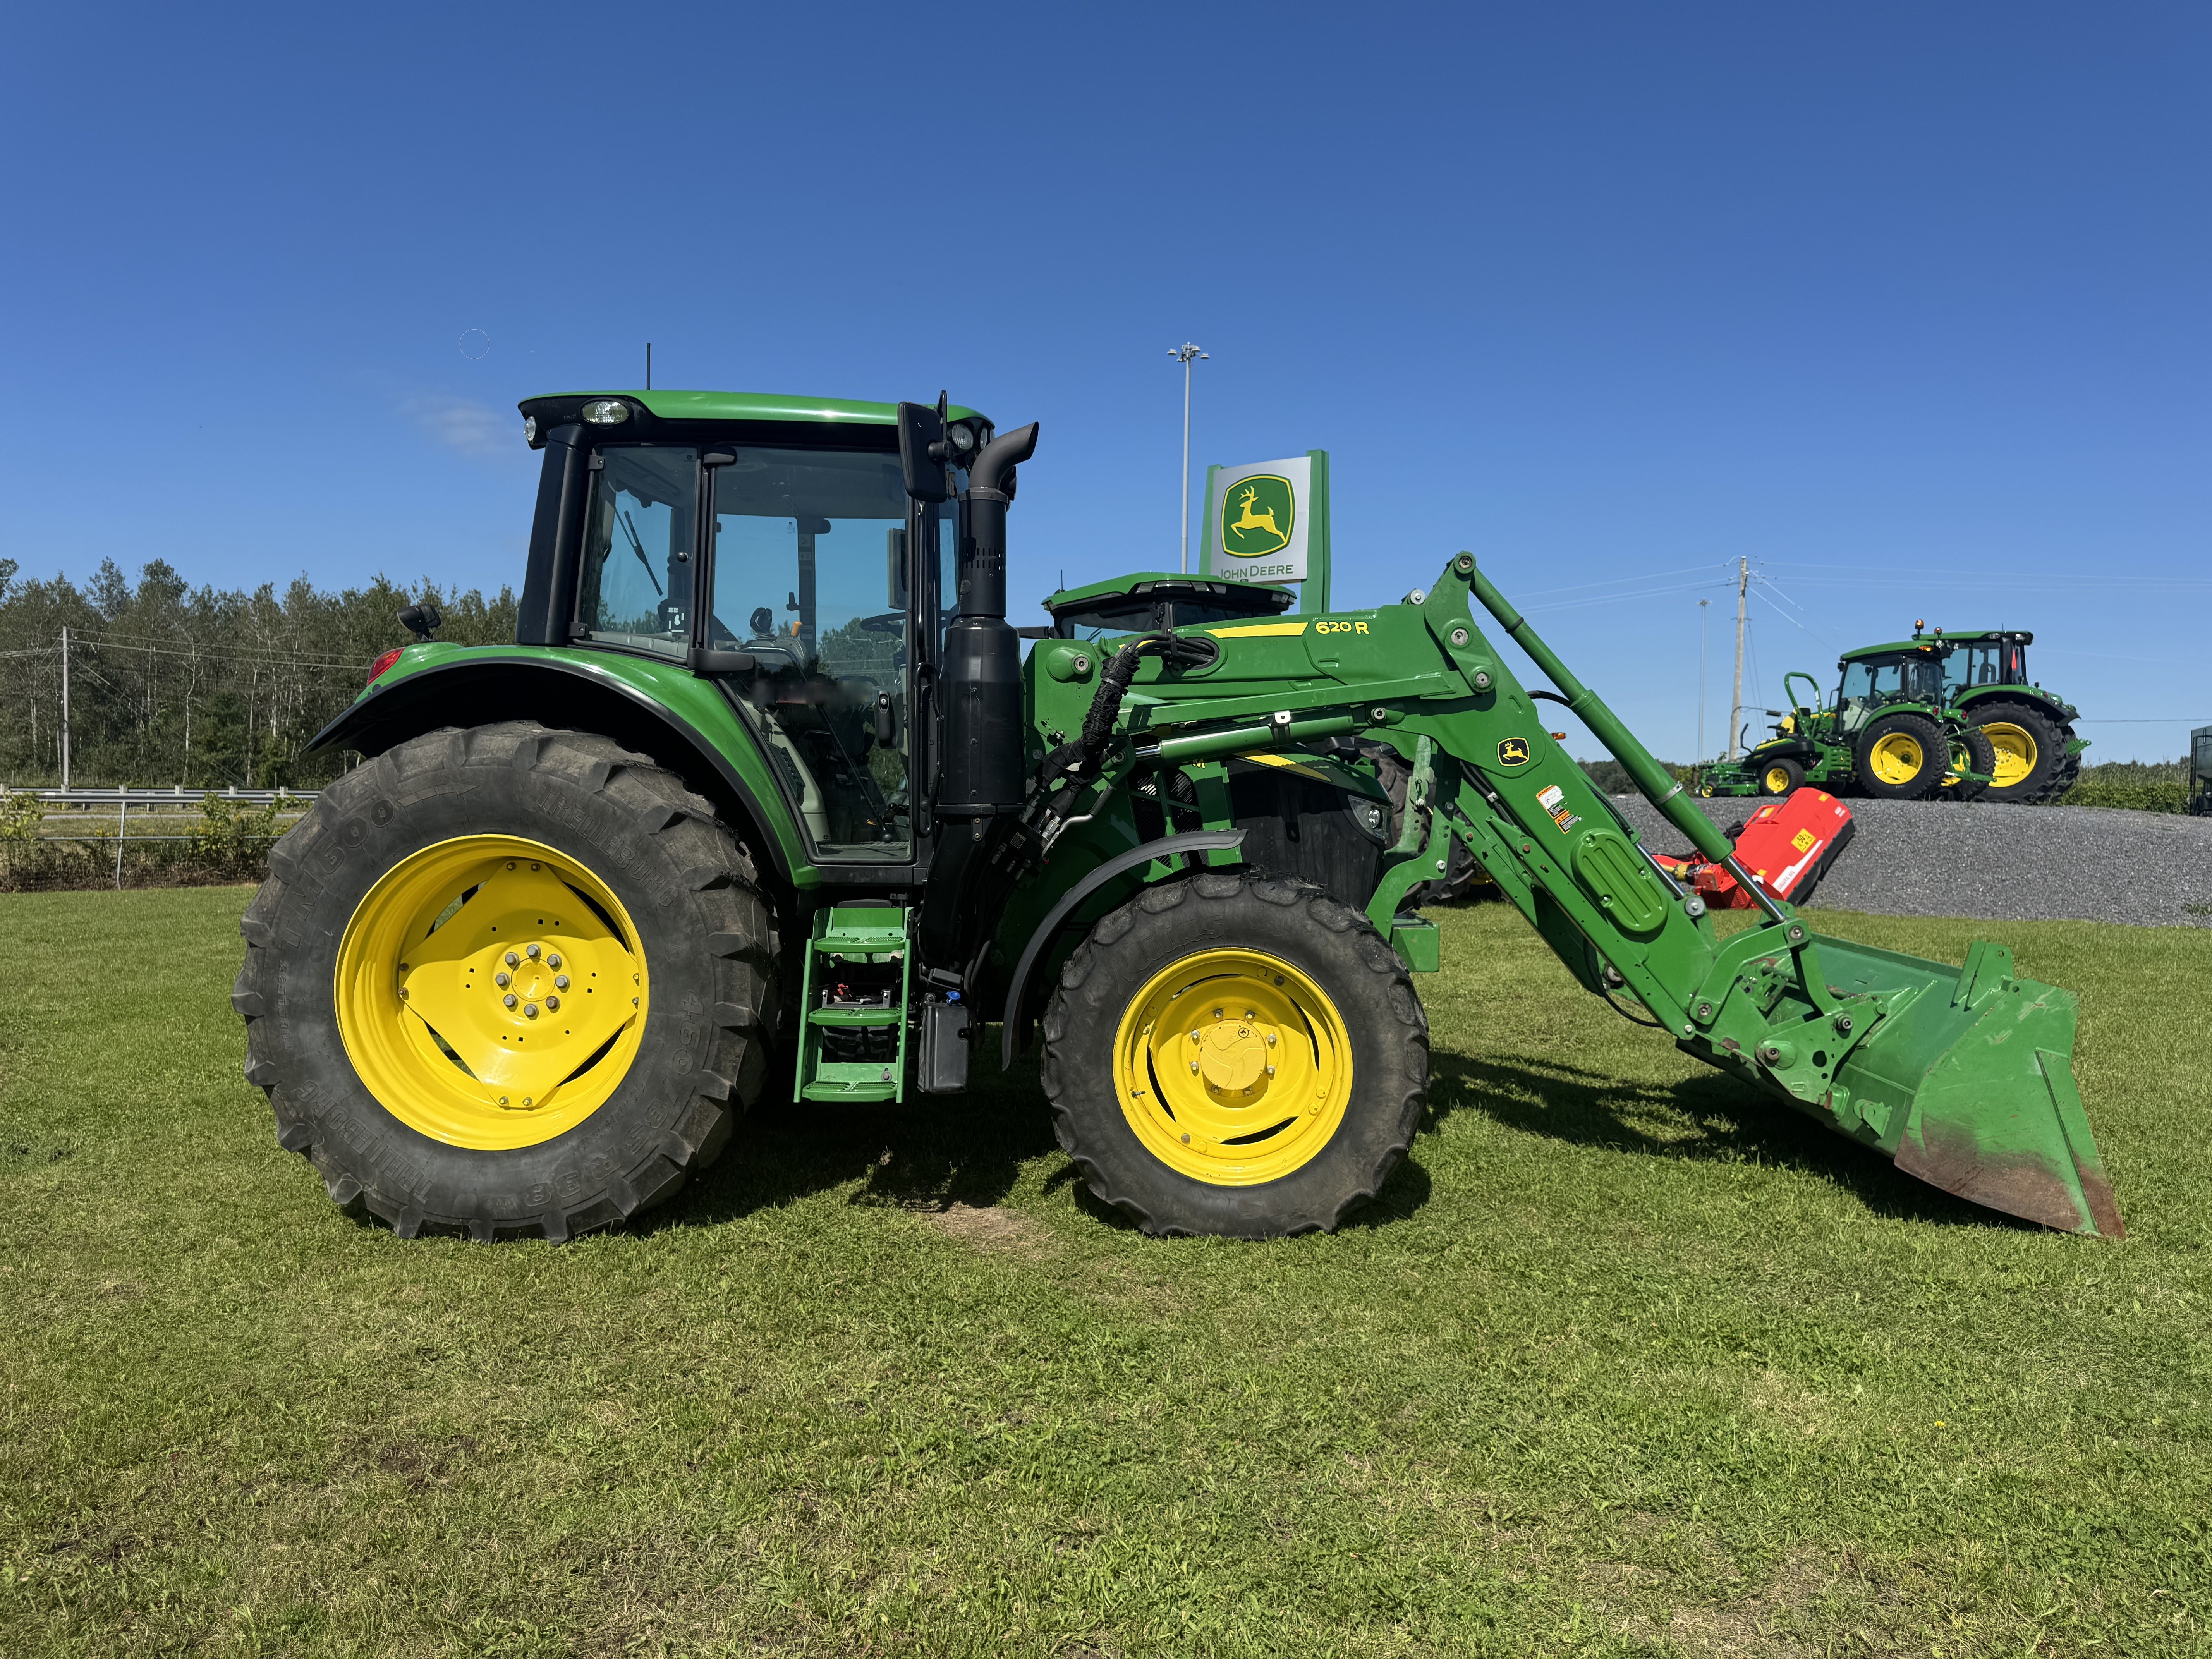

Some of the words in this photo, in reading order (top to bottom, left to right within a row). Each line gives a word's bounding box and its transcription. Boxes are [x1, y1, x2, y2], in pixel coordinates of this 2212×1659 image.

[1221, 568, 1248, 579] JOHN
[1250, 564, 1293, 577] DEERE
[536, 782, 678, 907] TRELLEBORG
[1111, 915, 1226, 996] Mitas
[276, 960, 293, 1050] TUBELESS
[297, 1080, 434, 1204] TRELLEBORG
